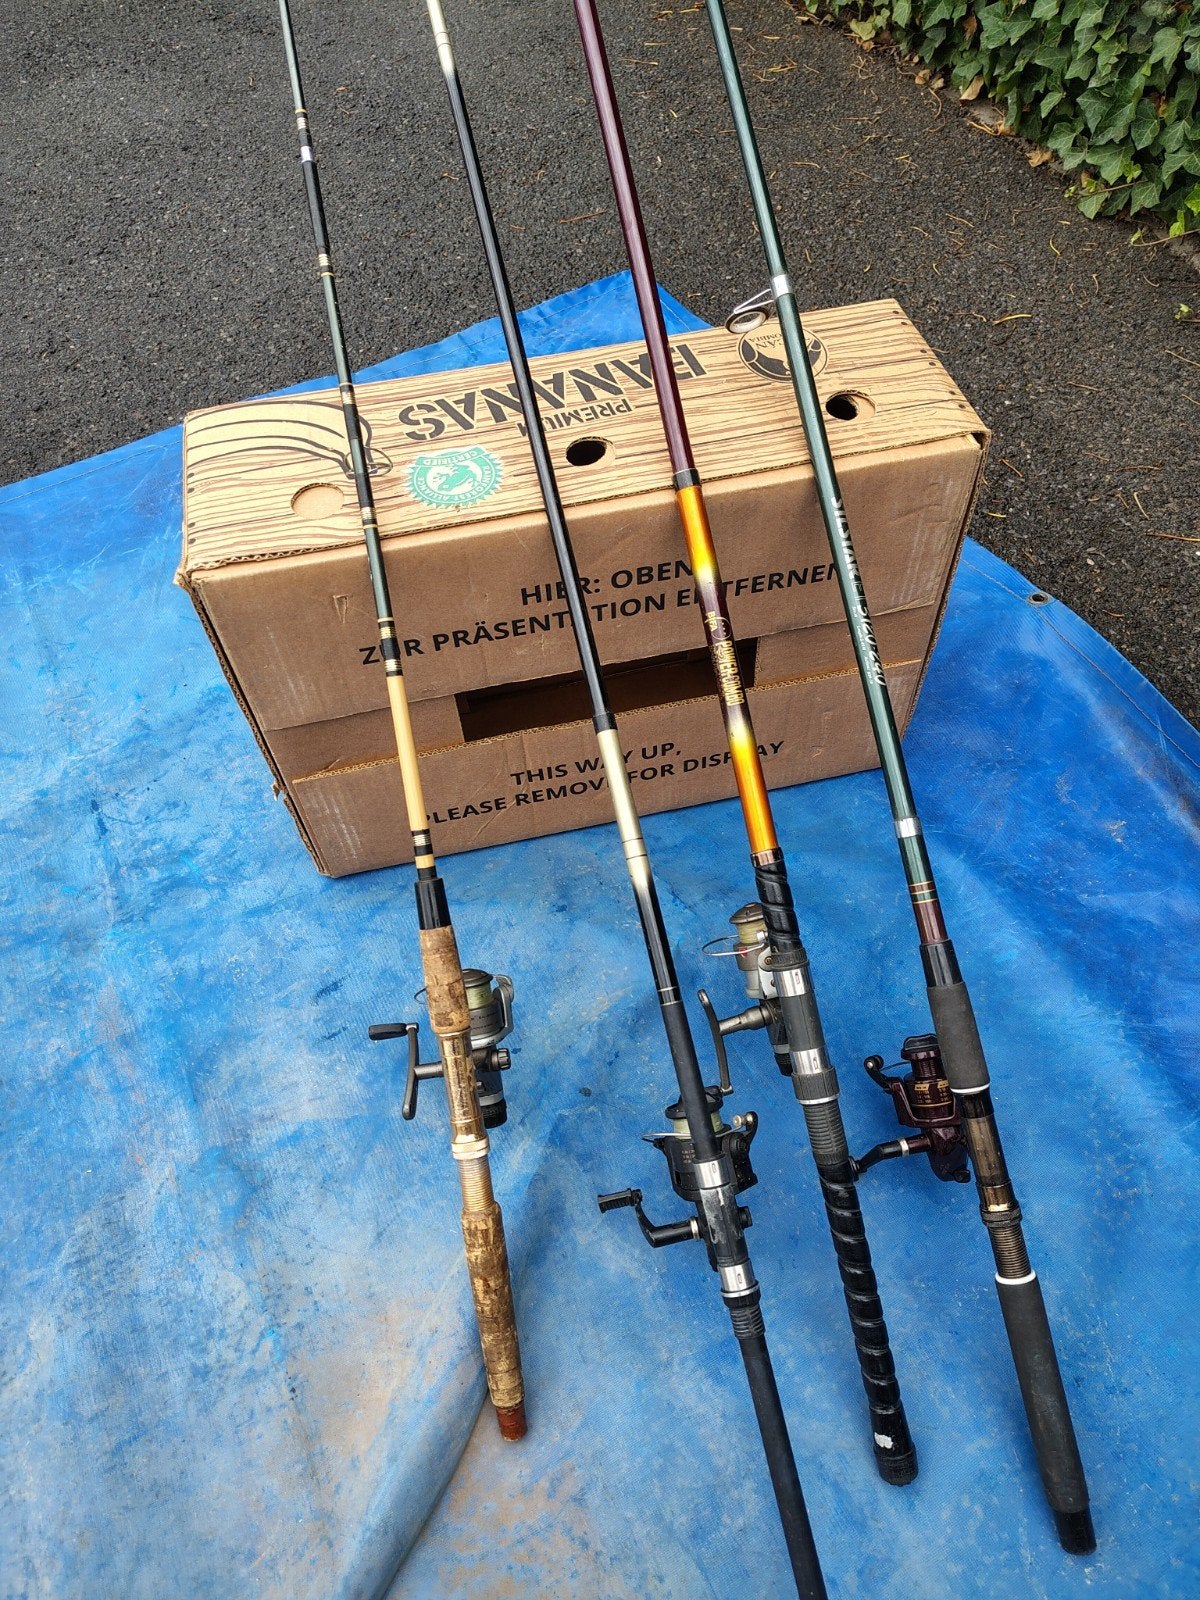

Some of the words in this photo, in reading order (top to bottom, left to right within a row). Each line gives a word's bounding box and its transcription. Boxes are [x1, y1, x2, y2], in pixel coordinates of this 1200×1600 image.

[423, 450, 478, 467] CERTIFIED
[418, 477, 450, 501] ALLIANCE
[453, 465, 492, 501] RAINFOREST
[611, 560, 694, 589] OBEN
[359, 638, 424, 665] ZR
[433, 593, 666, 652] PRÄSENTTION
[677, 563, 837, 607] ETFERNE
[510, 764, 569, 785] THIS
[575, 750, 634, 774] WY
[641, 742, 681, 760] UP,
[426, 796, 507, 824] LEASE
[515, 777, 610, 806] REMOV
[628, 764, 675, 784] FOR
[683, 740, 785, 772] DISPAY
